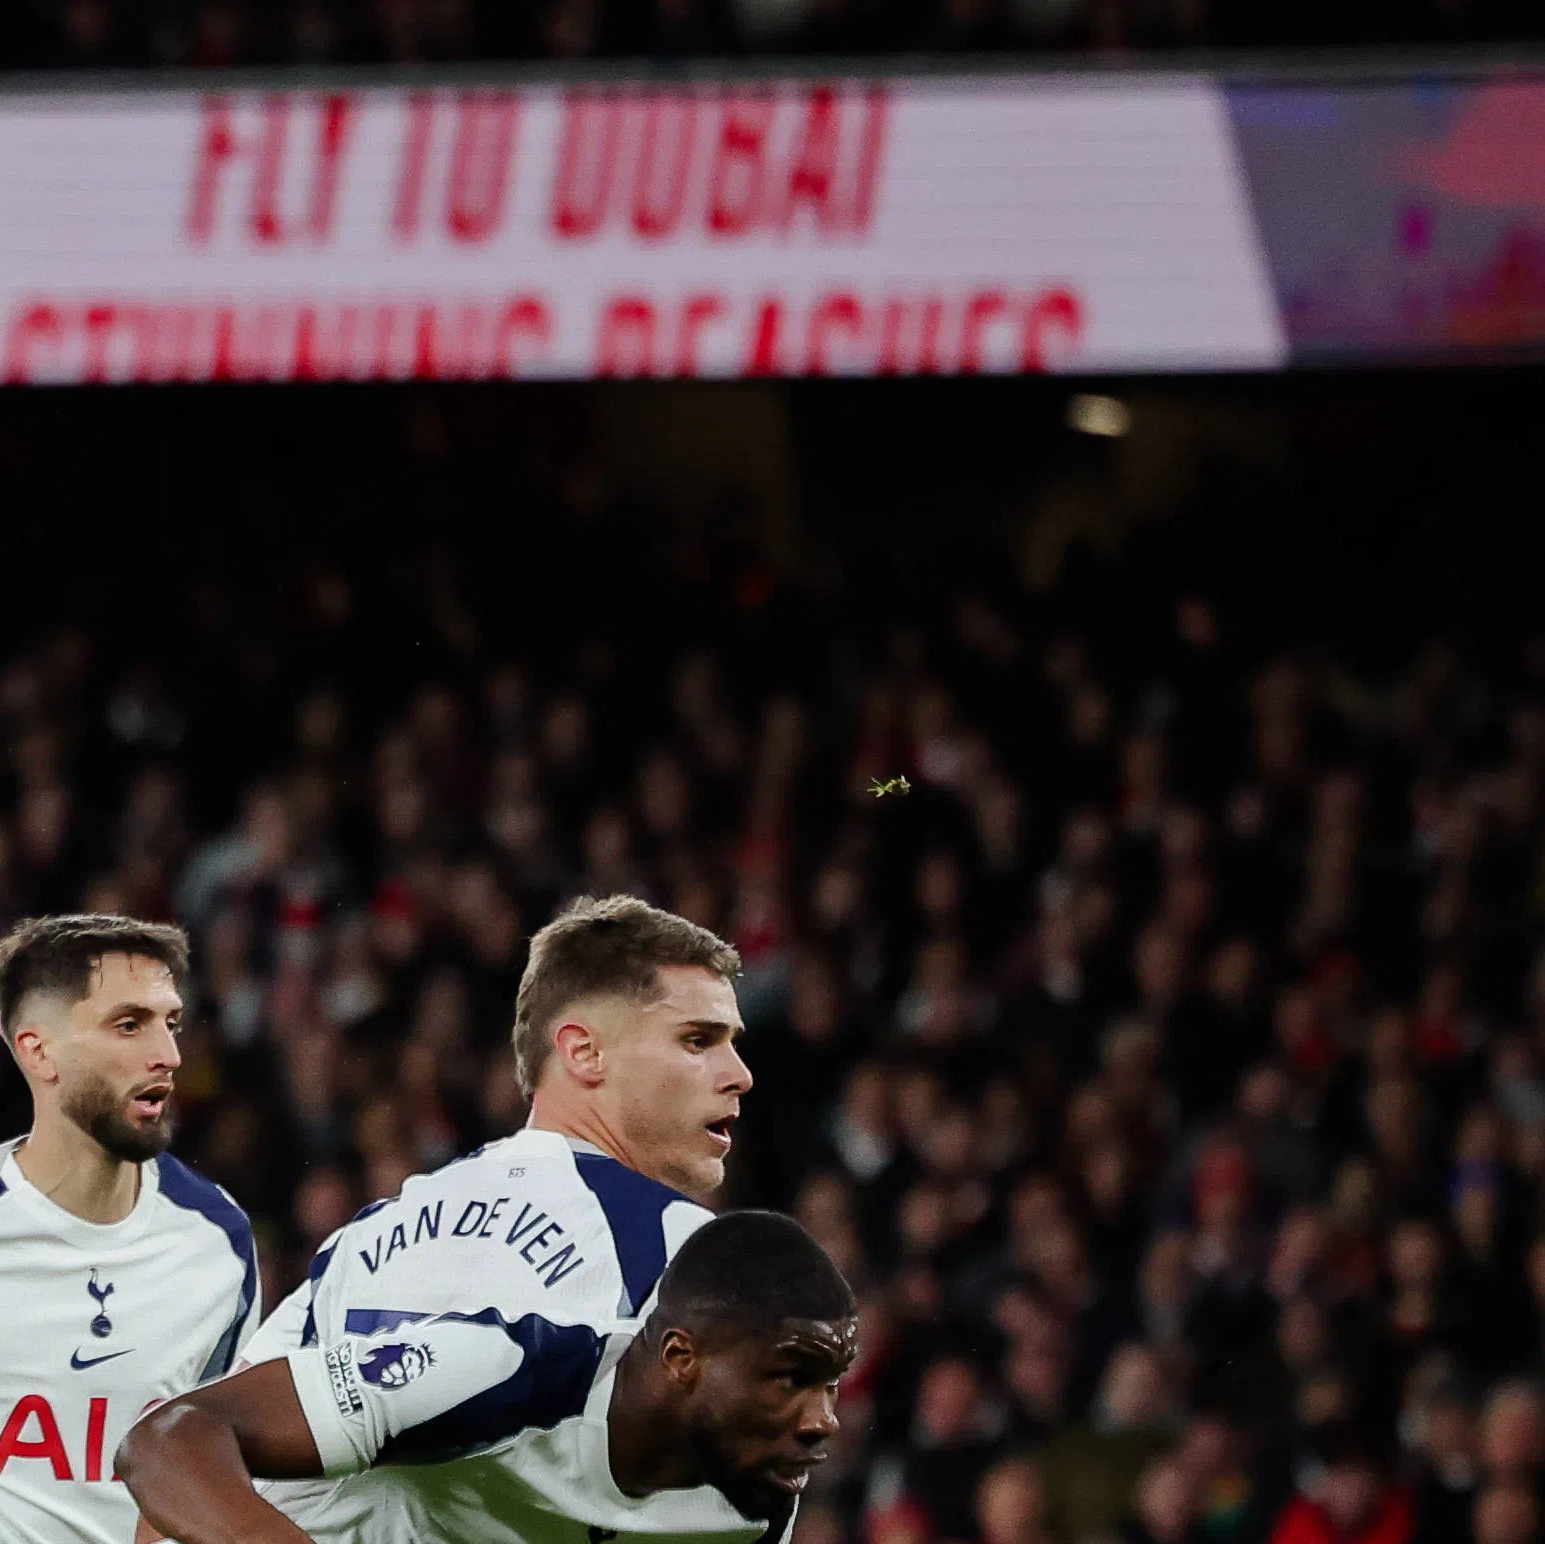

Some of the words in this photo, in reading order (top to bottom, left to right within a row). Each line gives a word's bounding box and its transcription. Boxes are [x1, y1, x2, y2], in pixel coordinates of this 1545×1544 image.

[358, 1200, 444, 1275] VAN
[451, 1197, 510, 1238] DE
[505, 1202, 585, 1290] VEN
